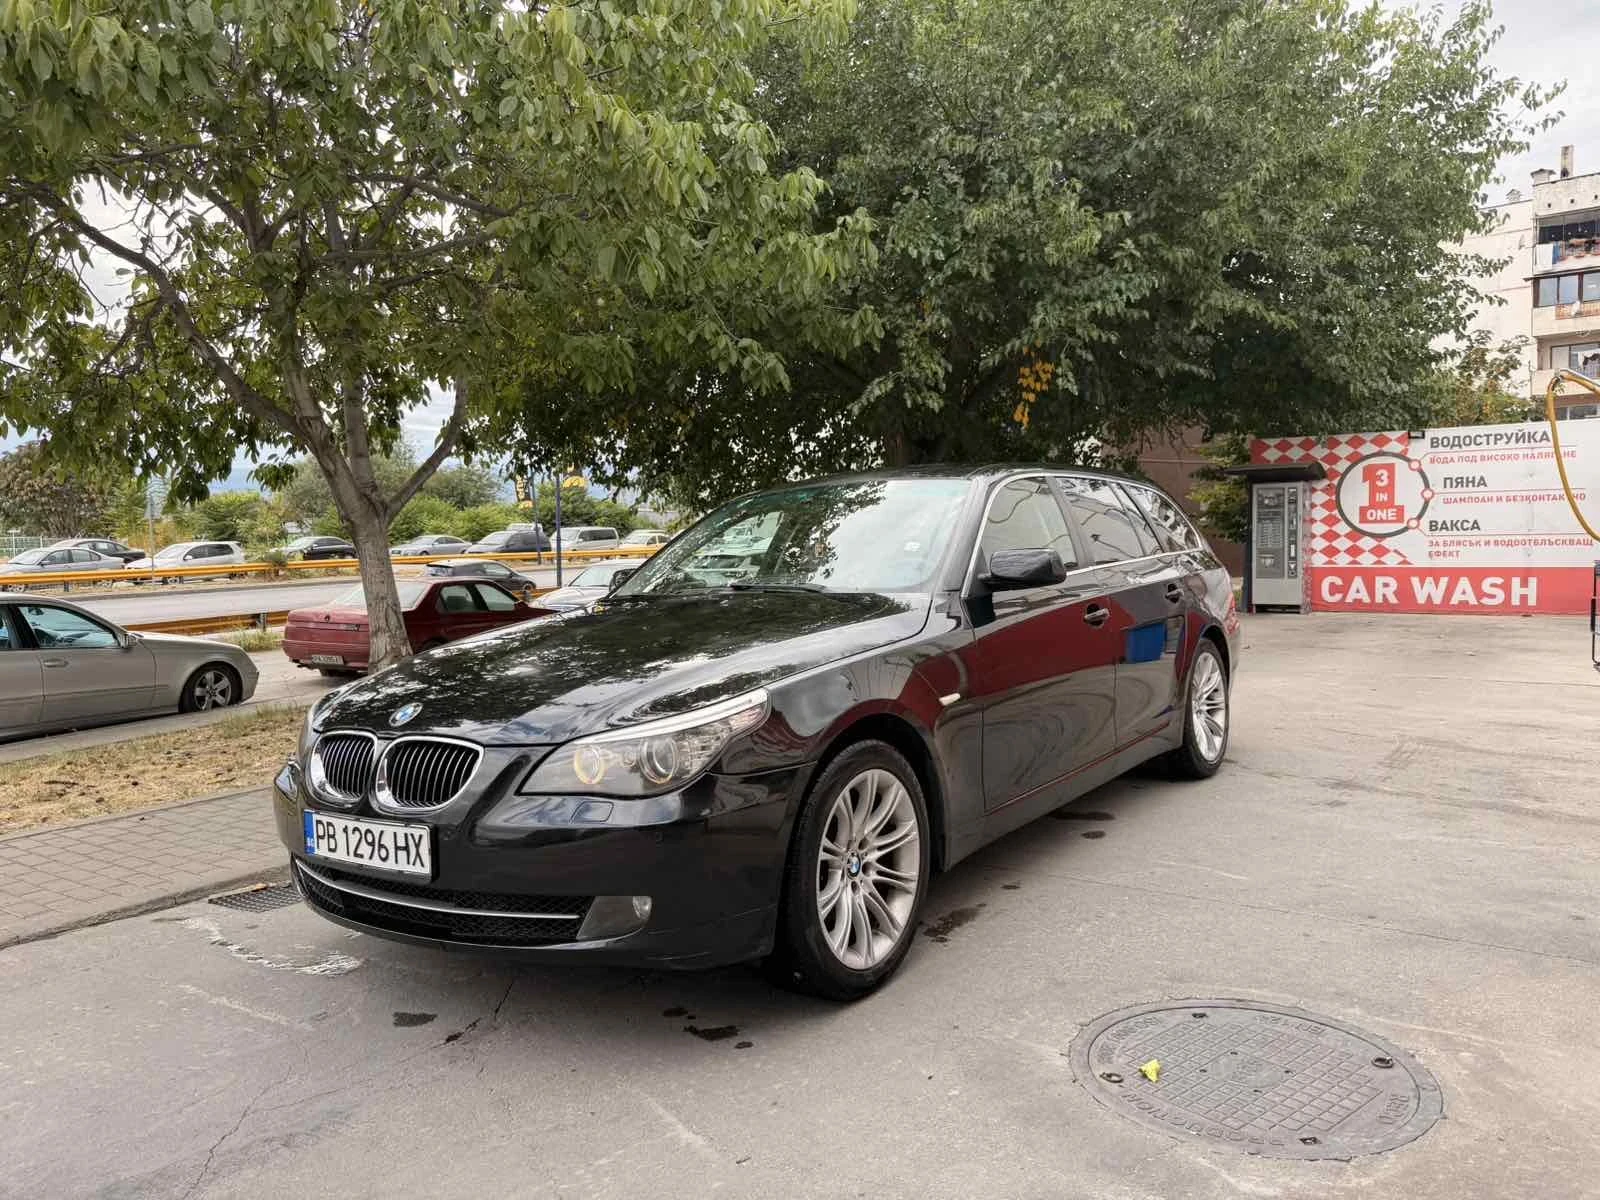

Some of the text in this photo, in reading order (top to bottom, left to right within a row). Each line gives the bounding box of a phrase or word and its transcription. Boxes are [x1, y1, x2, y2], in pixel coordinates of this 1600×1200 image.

[1430, 429, 1551, 449] ВОДОСТРУЙКА
[1429, 456, 1455, 464] ВОДА
[1458, 455, 1477, 463] ПОД
[1480, 453, 1520, 462] ВИСОКО
[1375, 468, 1389, 487] 3
[1443, 475, 1487, 488] ПЯНА
[1376, 492, 1388, 502] IN
[1443, 496, 1493, 504] ШАМПОАН
[1505, 493, 1586, 502] БЕЗКОНТАКНО
[1366, 508, 1397, 521] ONE
[1429, 519, 1481, 532] ВАКСА
[1320, 576, 1537, 606] CAR WASH
[316, 819, 425, 868] PB 1296 HX
